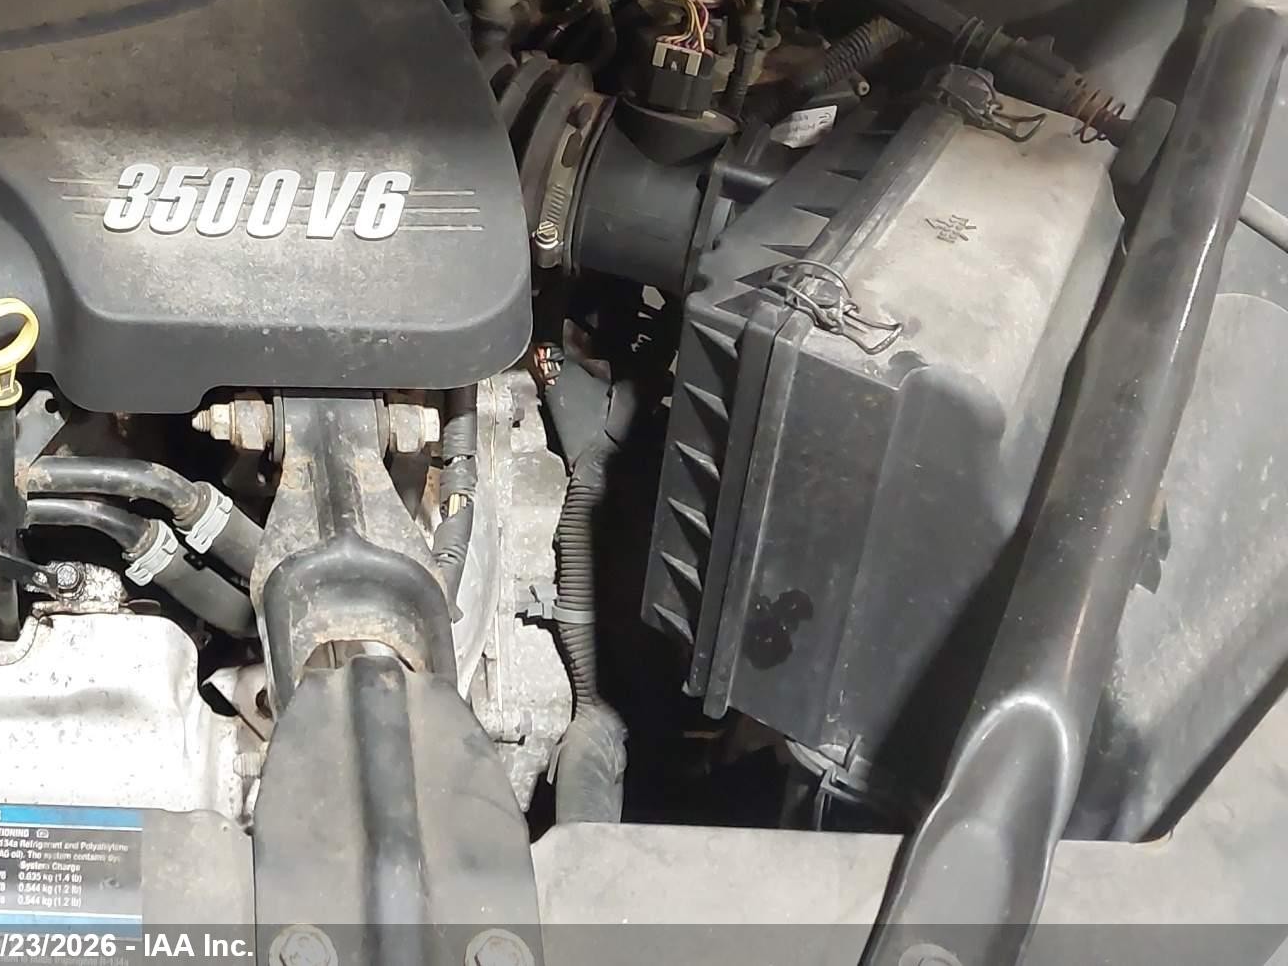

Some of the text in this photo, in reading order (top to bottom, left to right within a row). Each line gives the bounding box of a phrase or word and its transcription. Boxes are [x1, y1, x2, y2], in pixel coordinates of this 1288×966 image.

[102, 163, 412, 241] 3500 V6
[64, 842, 79, 850] and
[27, 850, 42, 859] The
[20, 861, 81, 872] System Charge
[43, 873, 52, 882] kg
[72, 874, 82, 883] lb)
[42, 884, 52, 894] kg
[72, 886, 82, 895] lb)
[42, 896, 52, 908] kg
[72, 898, 82, 908] lb)
